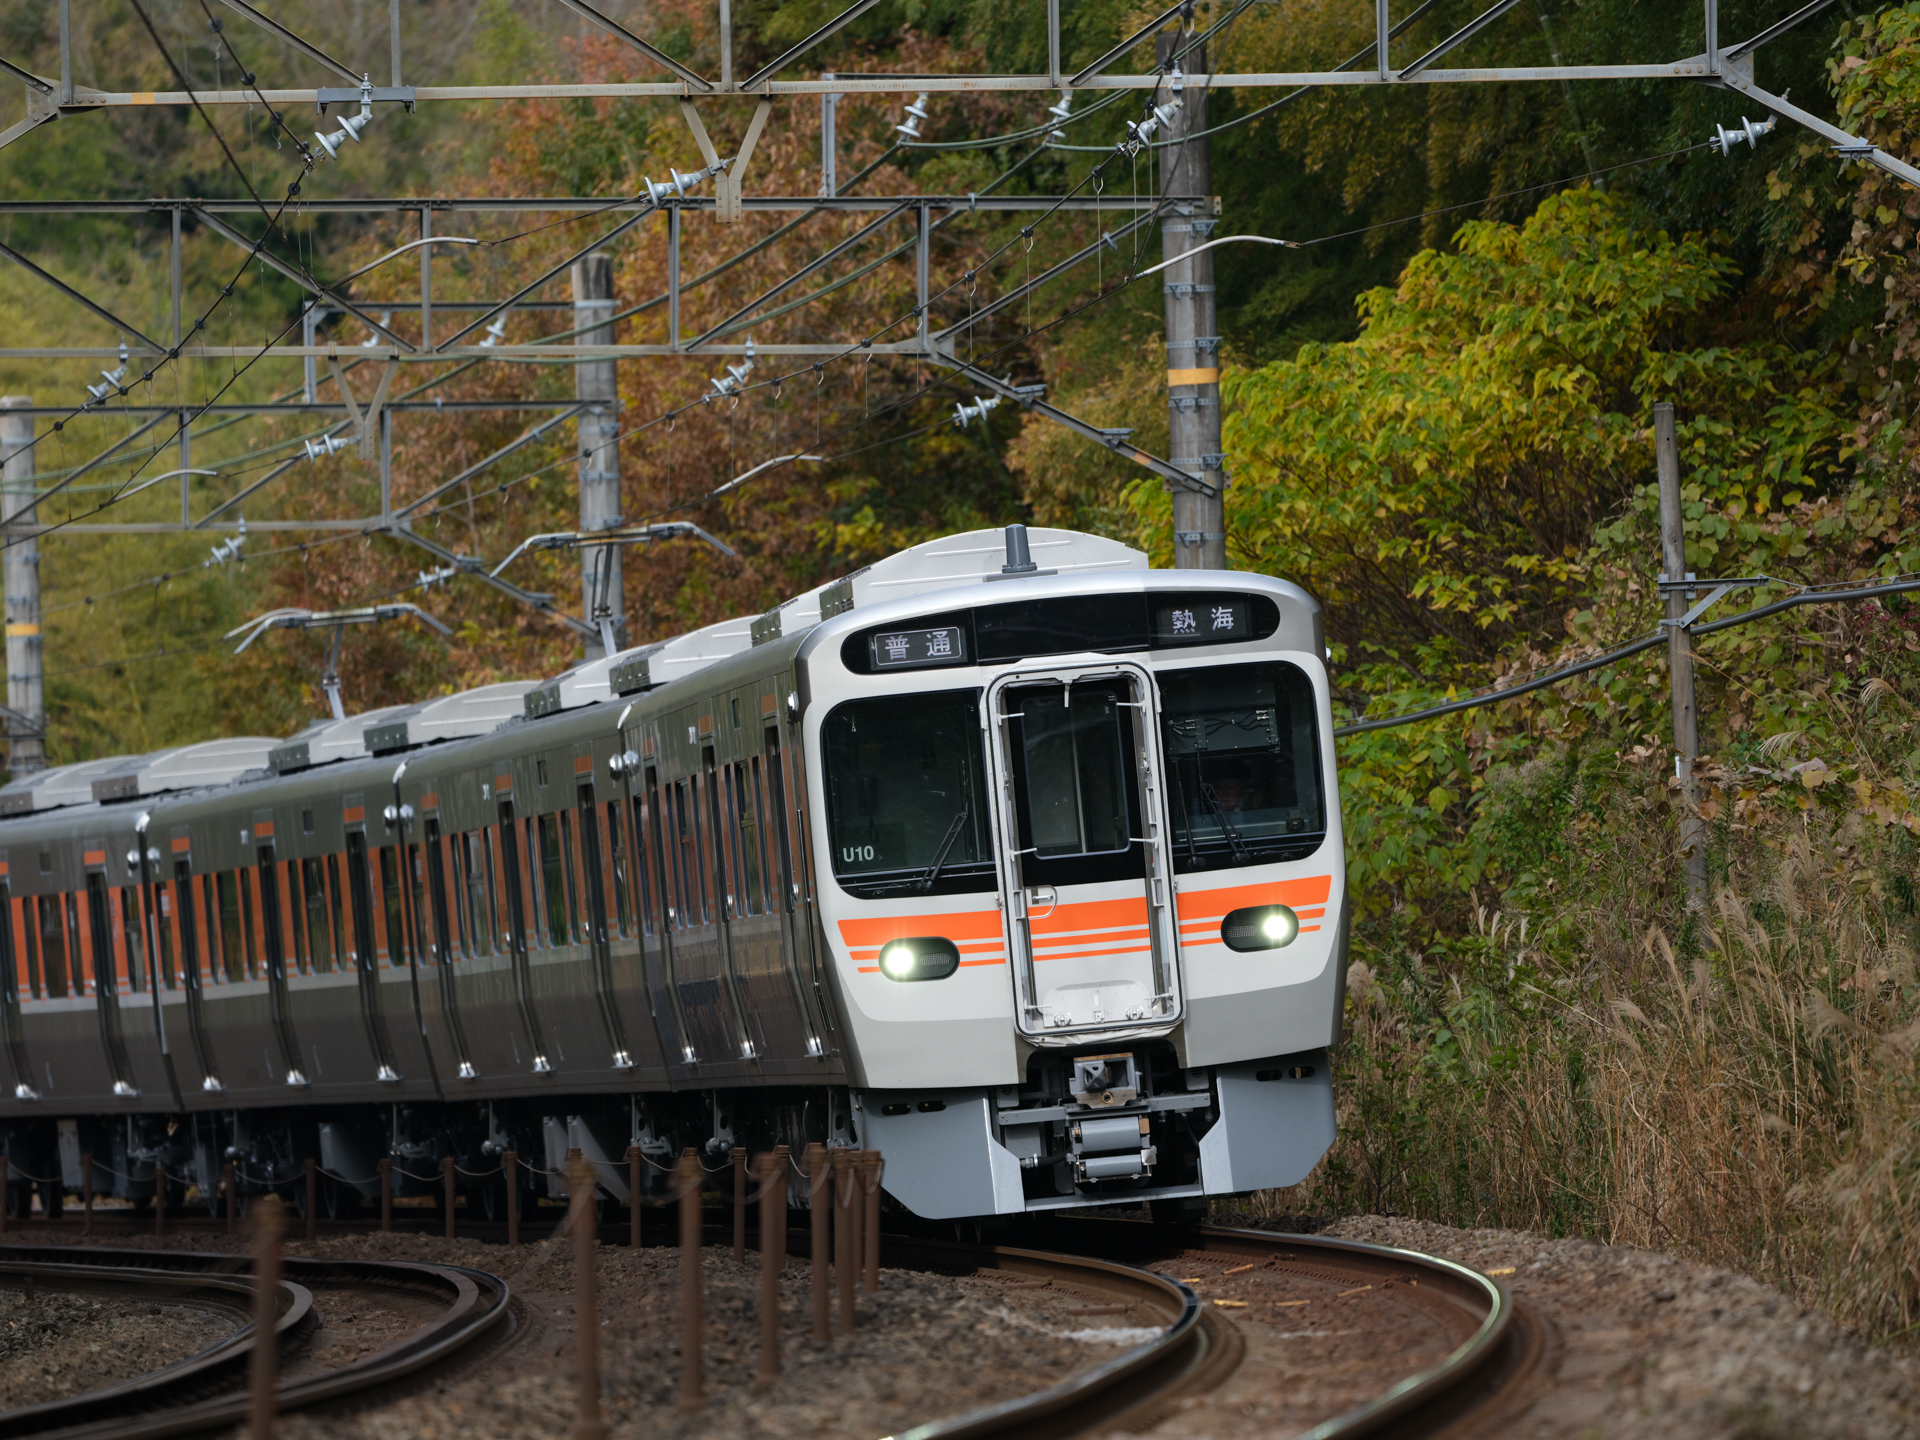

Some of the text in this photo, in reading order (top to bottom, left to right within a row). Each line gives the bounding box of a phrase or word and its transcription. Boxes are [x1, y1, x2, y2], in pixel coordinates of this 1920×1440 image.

[1171, 606, 1234, 634] 熱海
[884, 630, 952, 660] 普通
[842, 845, 875, 863] U10
